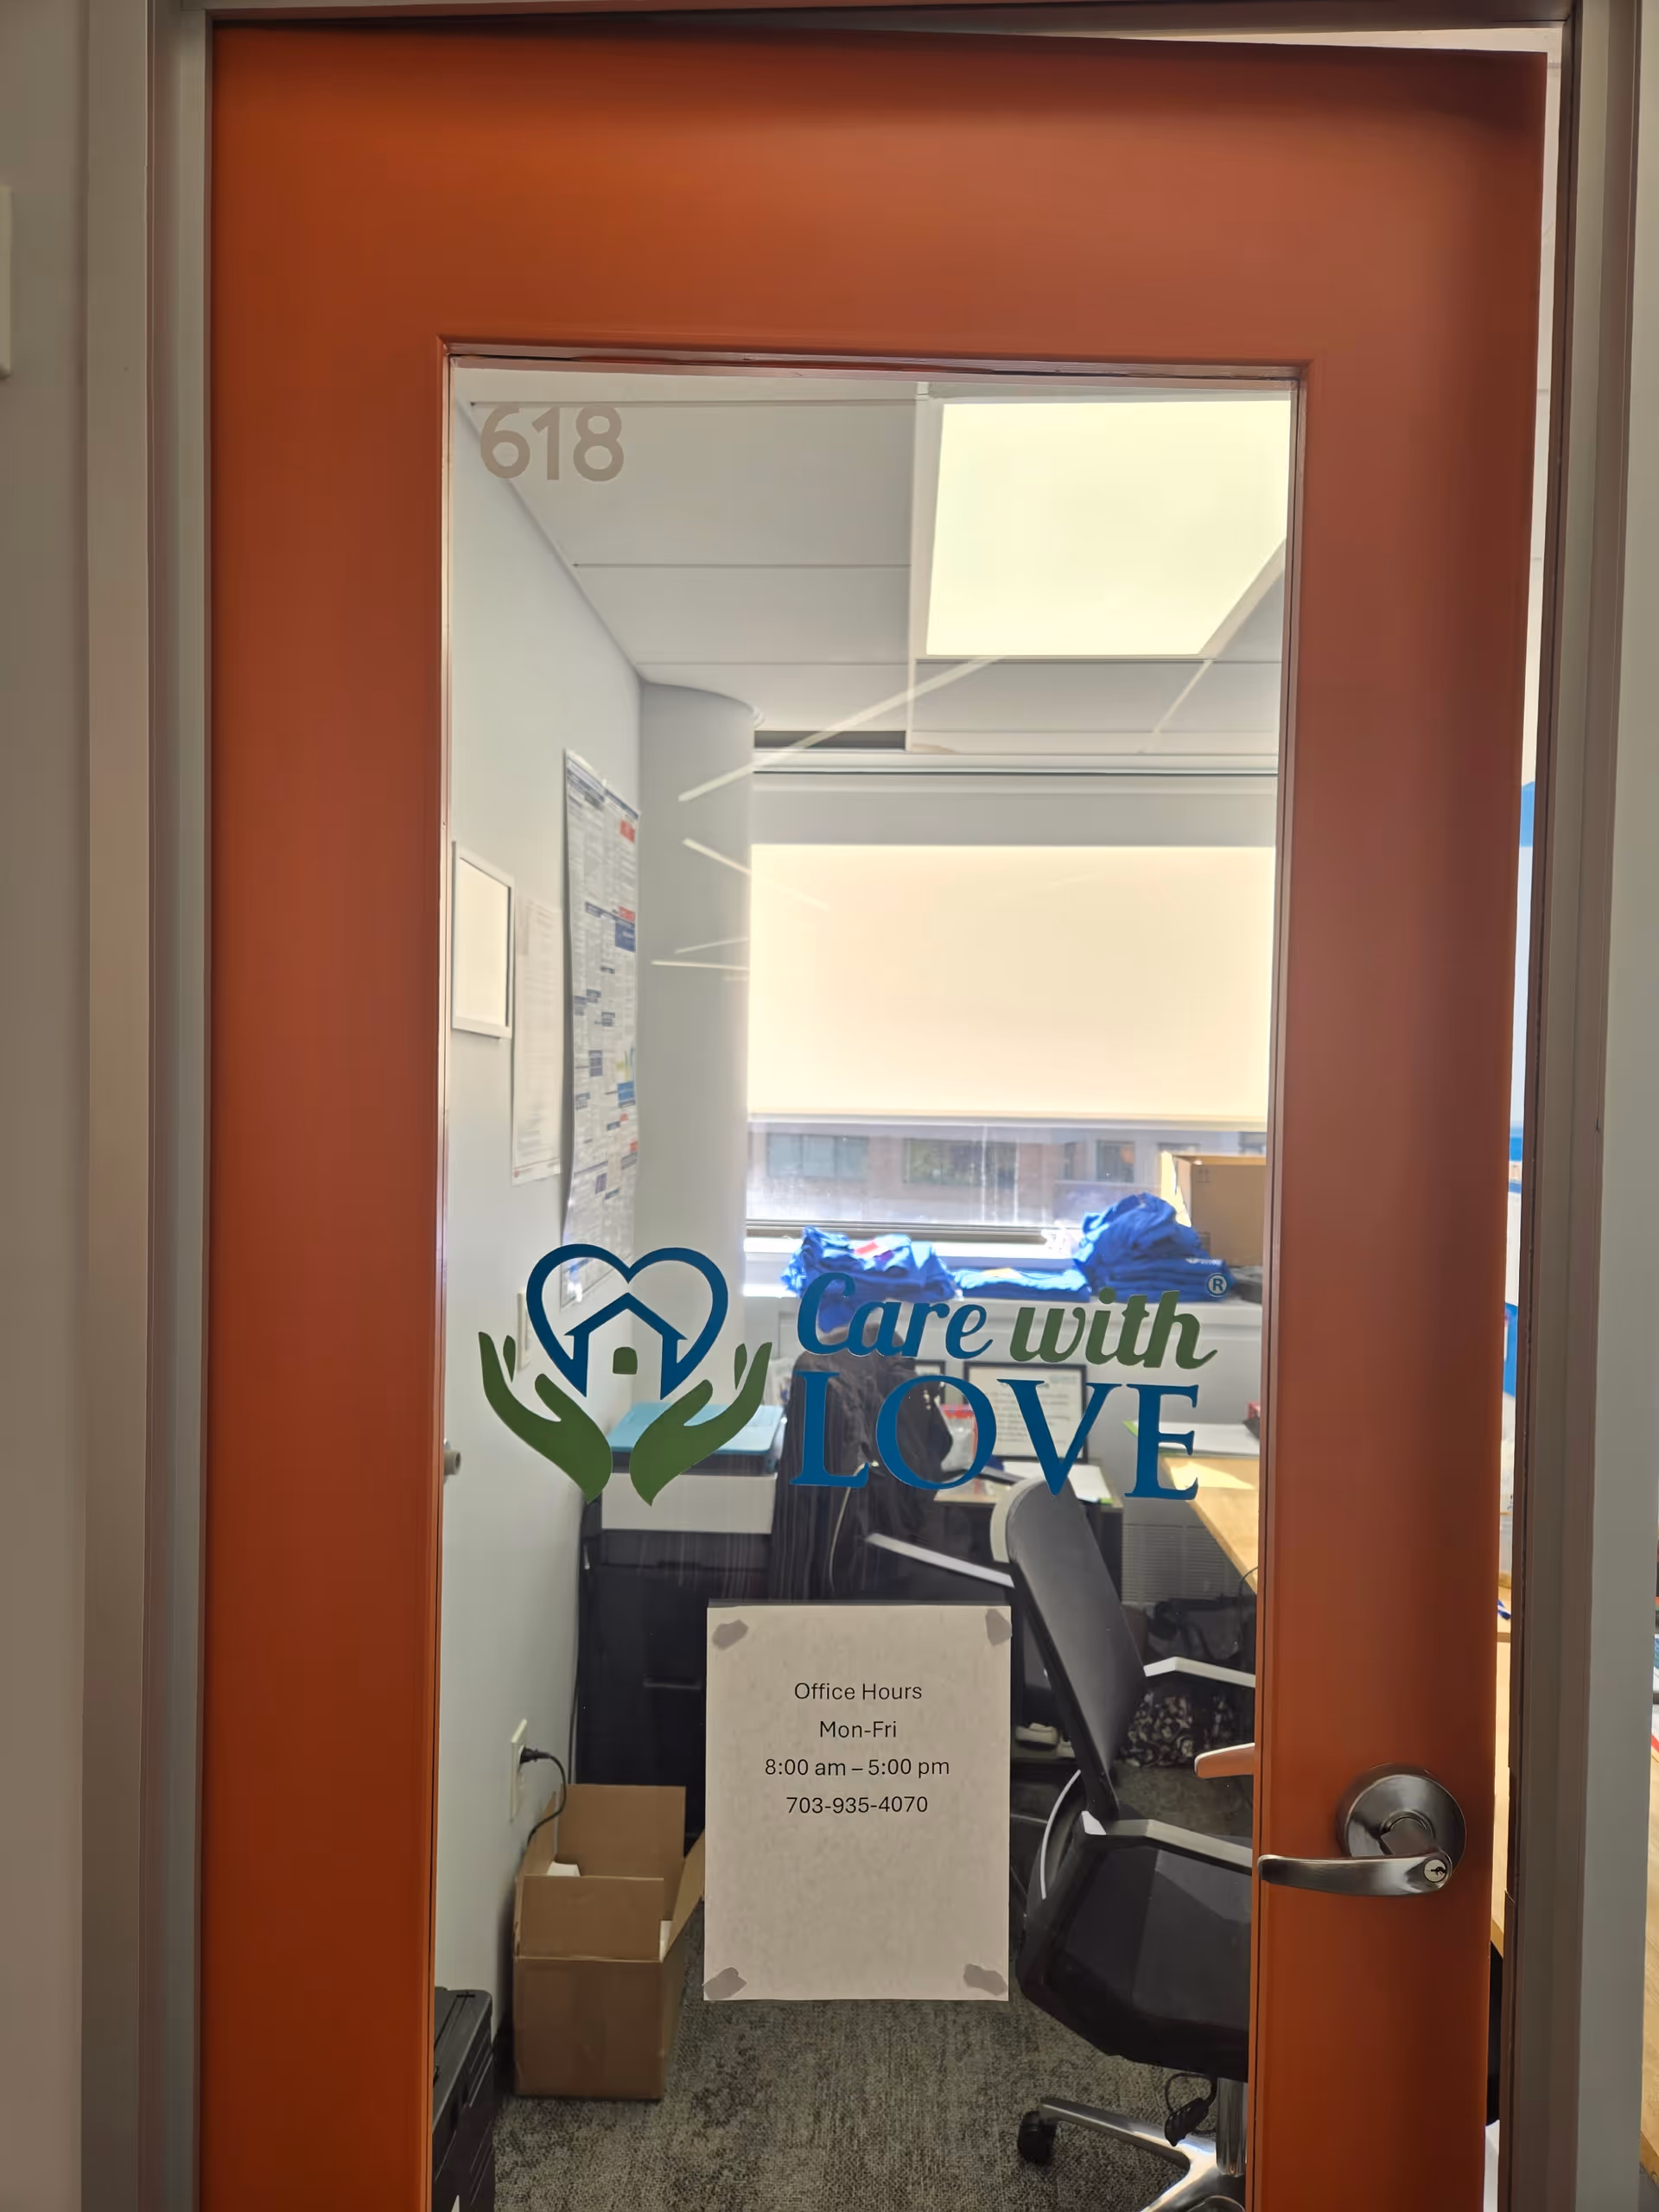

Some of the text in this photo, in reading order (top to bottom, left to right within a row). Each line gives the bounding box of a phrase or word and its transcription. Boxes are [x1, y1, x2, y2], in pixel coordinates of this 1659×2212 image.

[480, 407, 624, 482] 618
[797, 1272, 994, 1360] Care
[1009, 1287, 1218, 1369] with
[790, 1370, 1198, 1500] LOVE
[794, 1682, 922, 1700] Office Hours
[819, 1720, 897, 1738] Mon-Fri
[765, 1758, 809, 1776] 8:00
[815, 1762, 846, 1776] am
[868, 1758, 912, 1776] 5:00
[918, 1761, 950, 1778] pm
[786, 1796, 928, 1814] 703-935-4070
